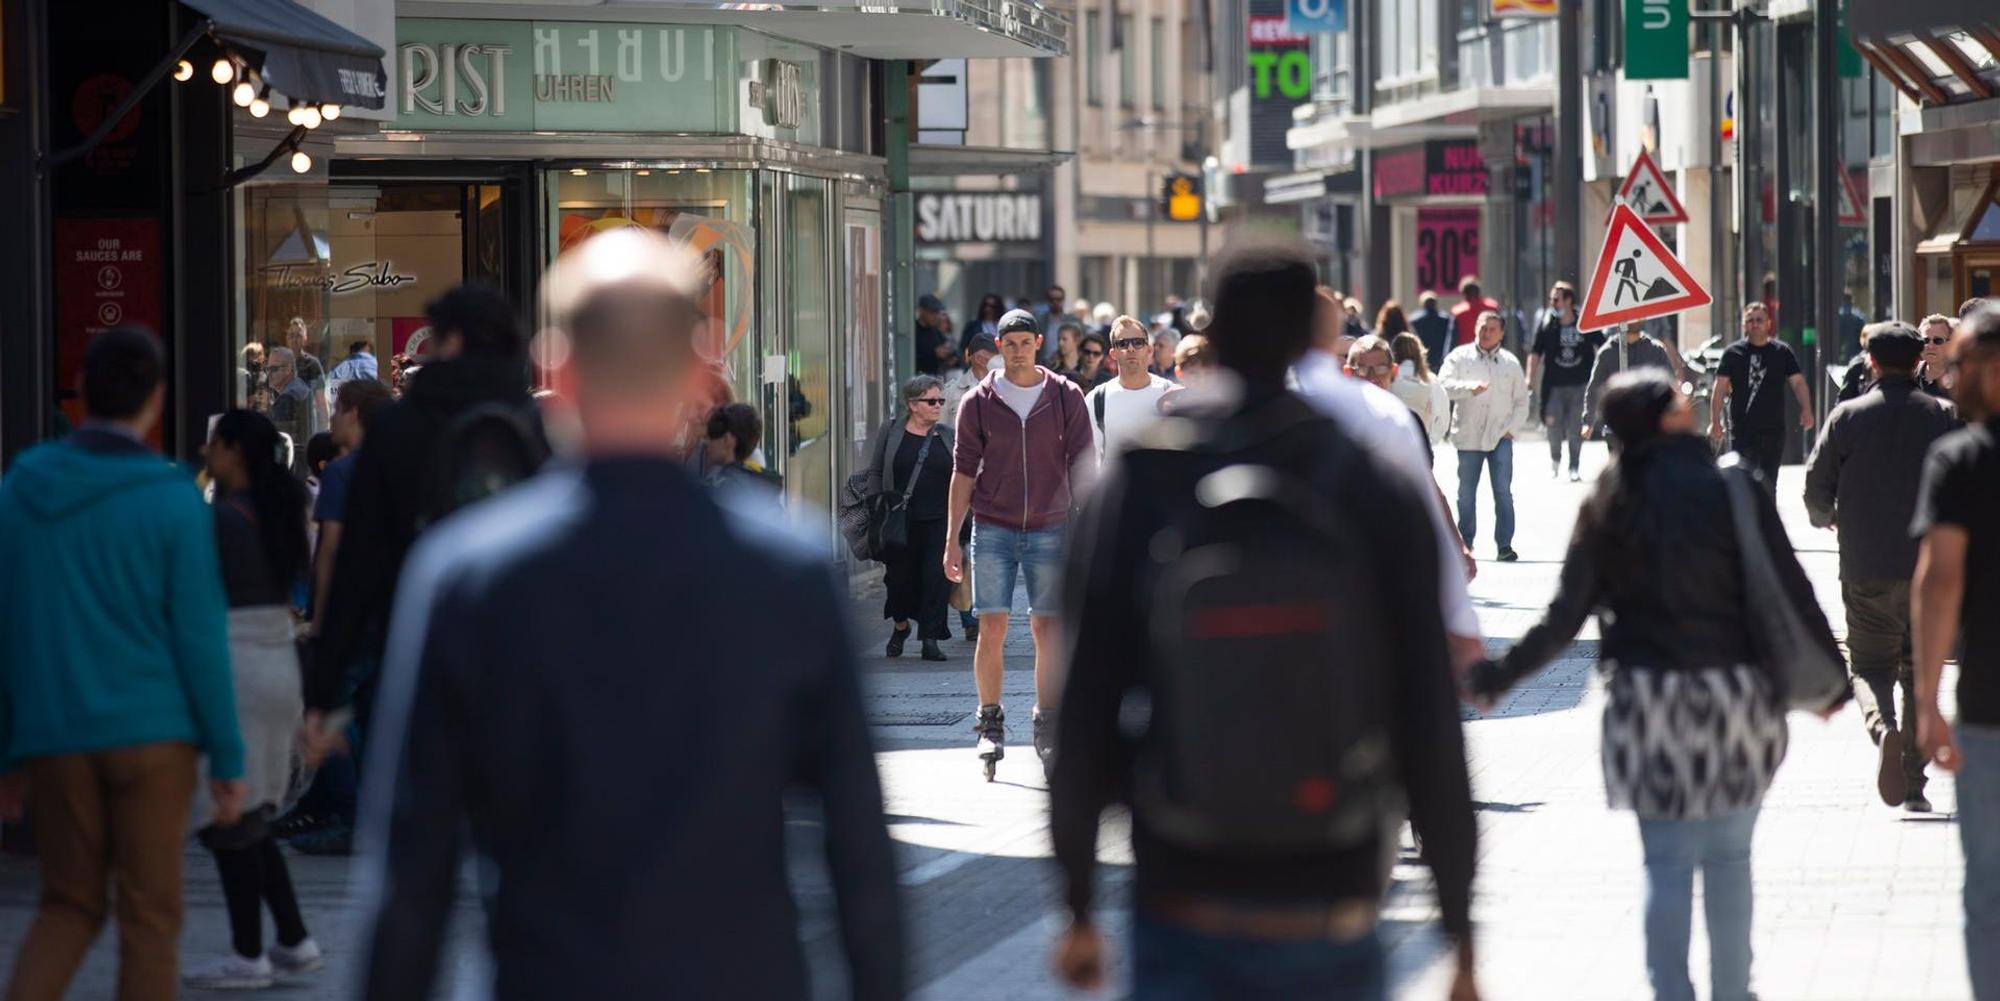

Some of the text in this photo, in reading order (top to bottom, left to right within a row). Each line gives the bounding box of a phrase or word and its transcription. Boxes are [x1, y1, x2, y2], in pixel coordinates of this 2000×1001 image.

[534, 73, 615, 102] UHREN
[919, 194, 1040, 240] SATURN
[76, 250, 143, 262] SAUCES ARE
[98, 239, 120, 250] OUR
[332, 262, 414, 293] Sabo
